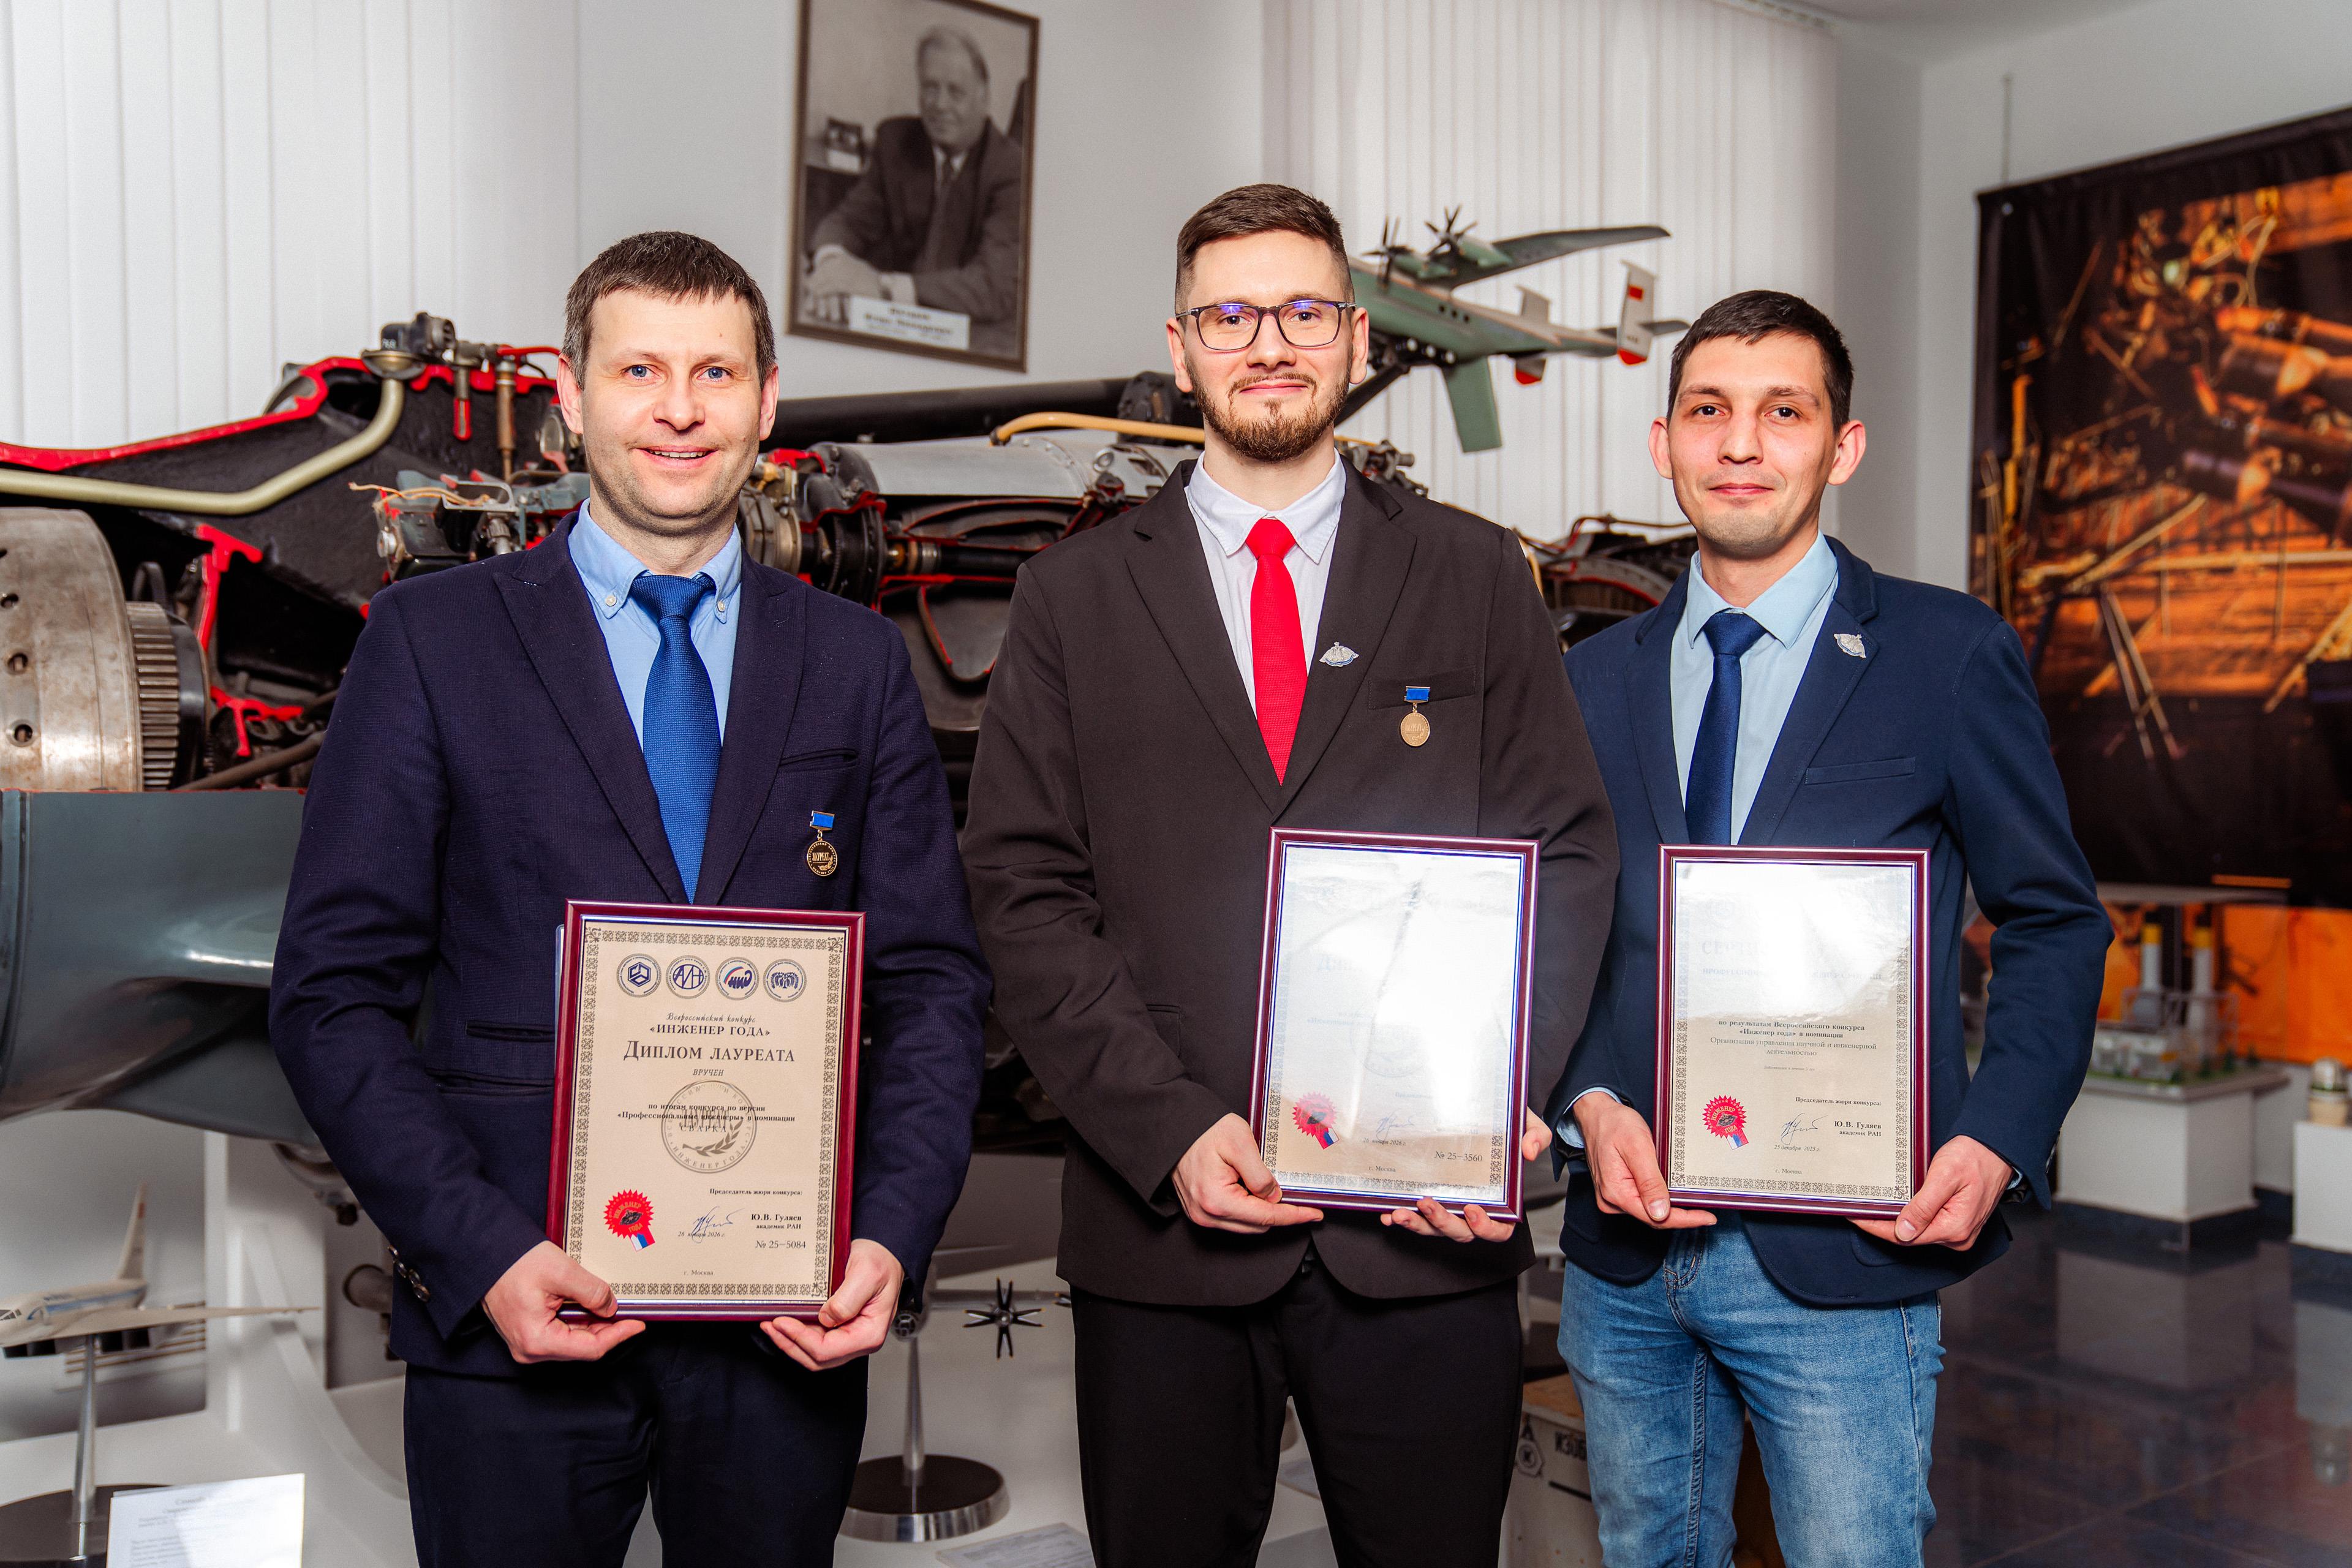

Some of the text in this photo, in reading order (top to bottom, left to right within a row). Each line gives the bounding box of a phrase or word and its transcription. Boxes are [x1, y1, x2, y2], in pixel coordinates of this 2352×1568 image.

[812, 852, 829, 861] ЛАУРЕАТ
[666, 1012, 756, 1025] Всероссийский конкурс
[1774, 1021, 1830, 1030] Всероссийского
[650, 1024, 771, 1037] «ИНЖЕНЕР ГОДА»
[1740, 1028, 1774, 1037] «Инженер
[1710, 1037, 1754, 1046] Организация
[693, 1068, 724, 1077] ВРУЧЕН
[617, 1111, 698, 1120] «Профессиональные
[1711, 1106, 1736, 1121] ИНЖЕНЕР
[1724, 1125, 1738, 1134] ГОДА
[1434, 1151, 1445, 1159] №
[775, 1214, 802, 1223] Гуляев
[755, 1240, 766, 1249] №
